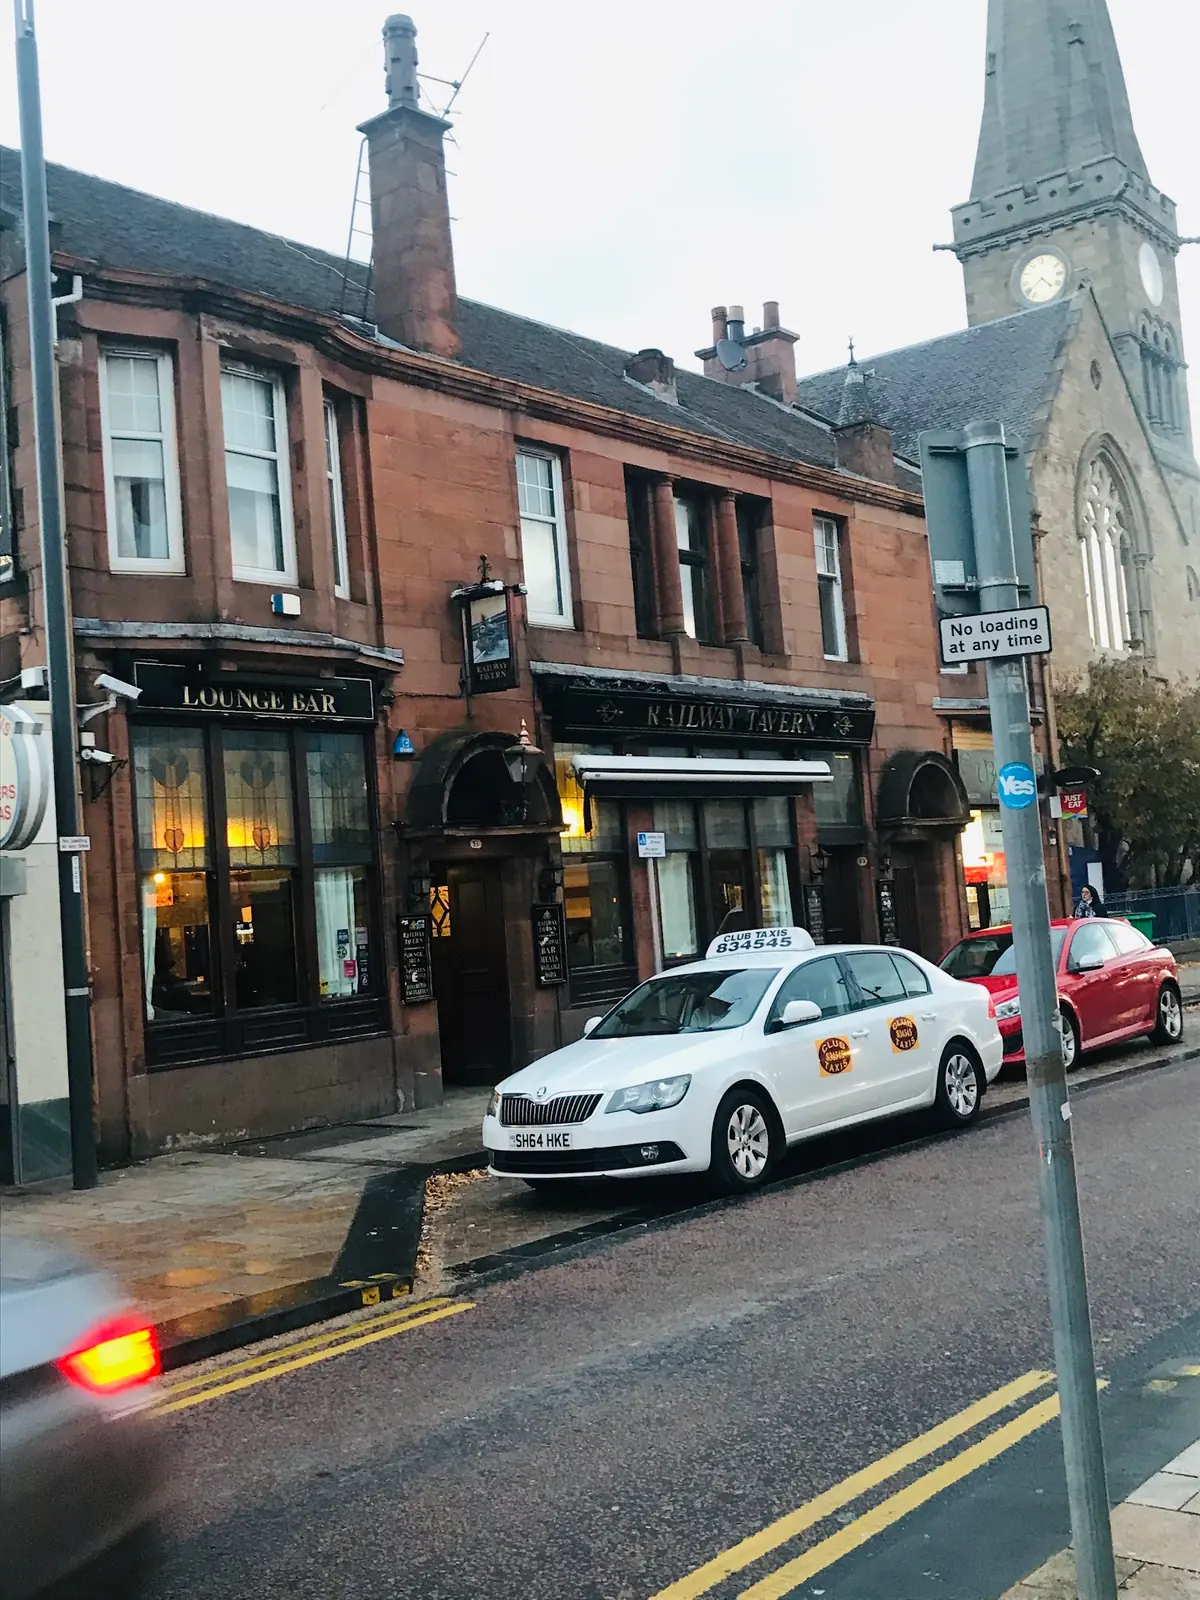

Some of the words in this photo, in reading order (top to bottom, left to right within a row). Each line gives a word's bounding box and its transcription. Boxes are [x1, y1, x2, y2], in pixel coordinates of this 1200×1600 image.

[950, 623, 973, 637] No
[980, 616, 1039, 634] loading
[949, 640, 966, 654] at
[972, 638, 1000, 652] any
[1007, 633, 1043, 647] time
[182, 685, 285, 710] LOUNGE
[291, 692, 337, 714] BAR
[648, 703, 739, 731] RAILWAY
[747, 708, 819, 734] TAVERN
[999, 775, 1035, 796] Yes
[1063, 794, 1082, 804] JUST
[1068, 801, 1082, 809] EAT
[723, 932, 752, 942] CLUB
[755, 929, 788, 939] TAXIS
[541, 946, 557, 954] BAR
[716, 936, 792, 953] 834545
[892, 1018, 914, 1031] CLUB
[821, 1040, 846, 1053] CLUB
[895, 1036, 916, 1049] TAXIS
[825, 1058, 849, 1072] TAXIS
[515, 1133, 544, 1148] SH64
[546, 1133, 571, 1148] HKE
